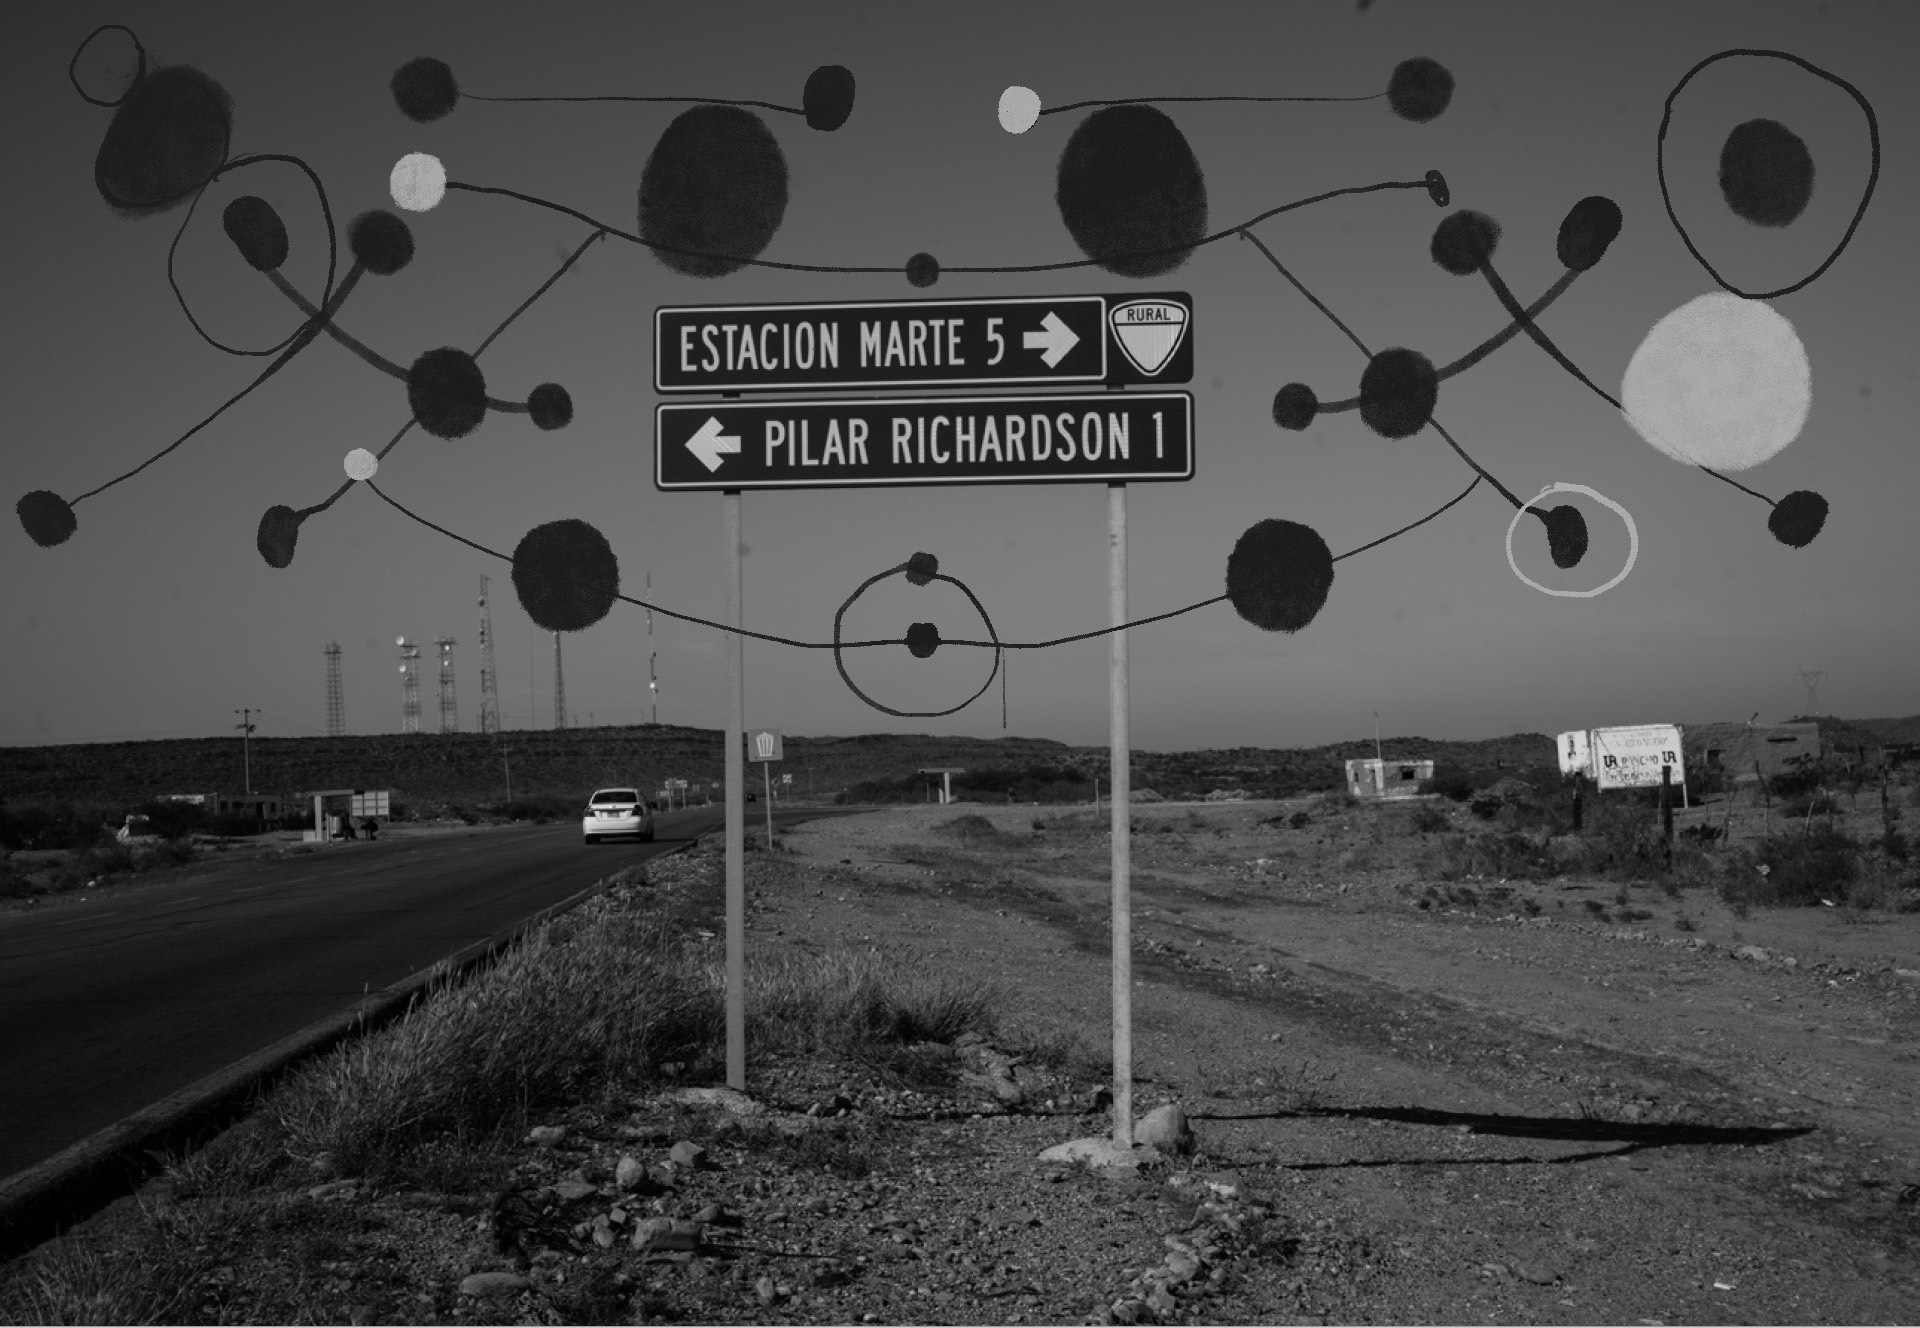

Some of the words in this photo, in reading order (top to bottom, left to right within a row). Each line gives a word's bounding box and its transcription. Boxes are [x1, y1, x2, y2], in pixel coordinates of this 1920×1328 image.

[1127, 307, 1172, 321] RURAL
[680, 321, 839, 373] ESTACION
[860, 318, 965, 368] MARTE
[987, 317, 1005, 366] 5
[765, 418, 869, 467] PILAR
[892, 411, 1130, 464] RICHARDSON
[1152, 411, 1163, 459] 1
